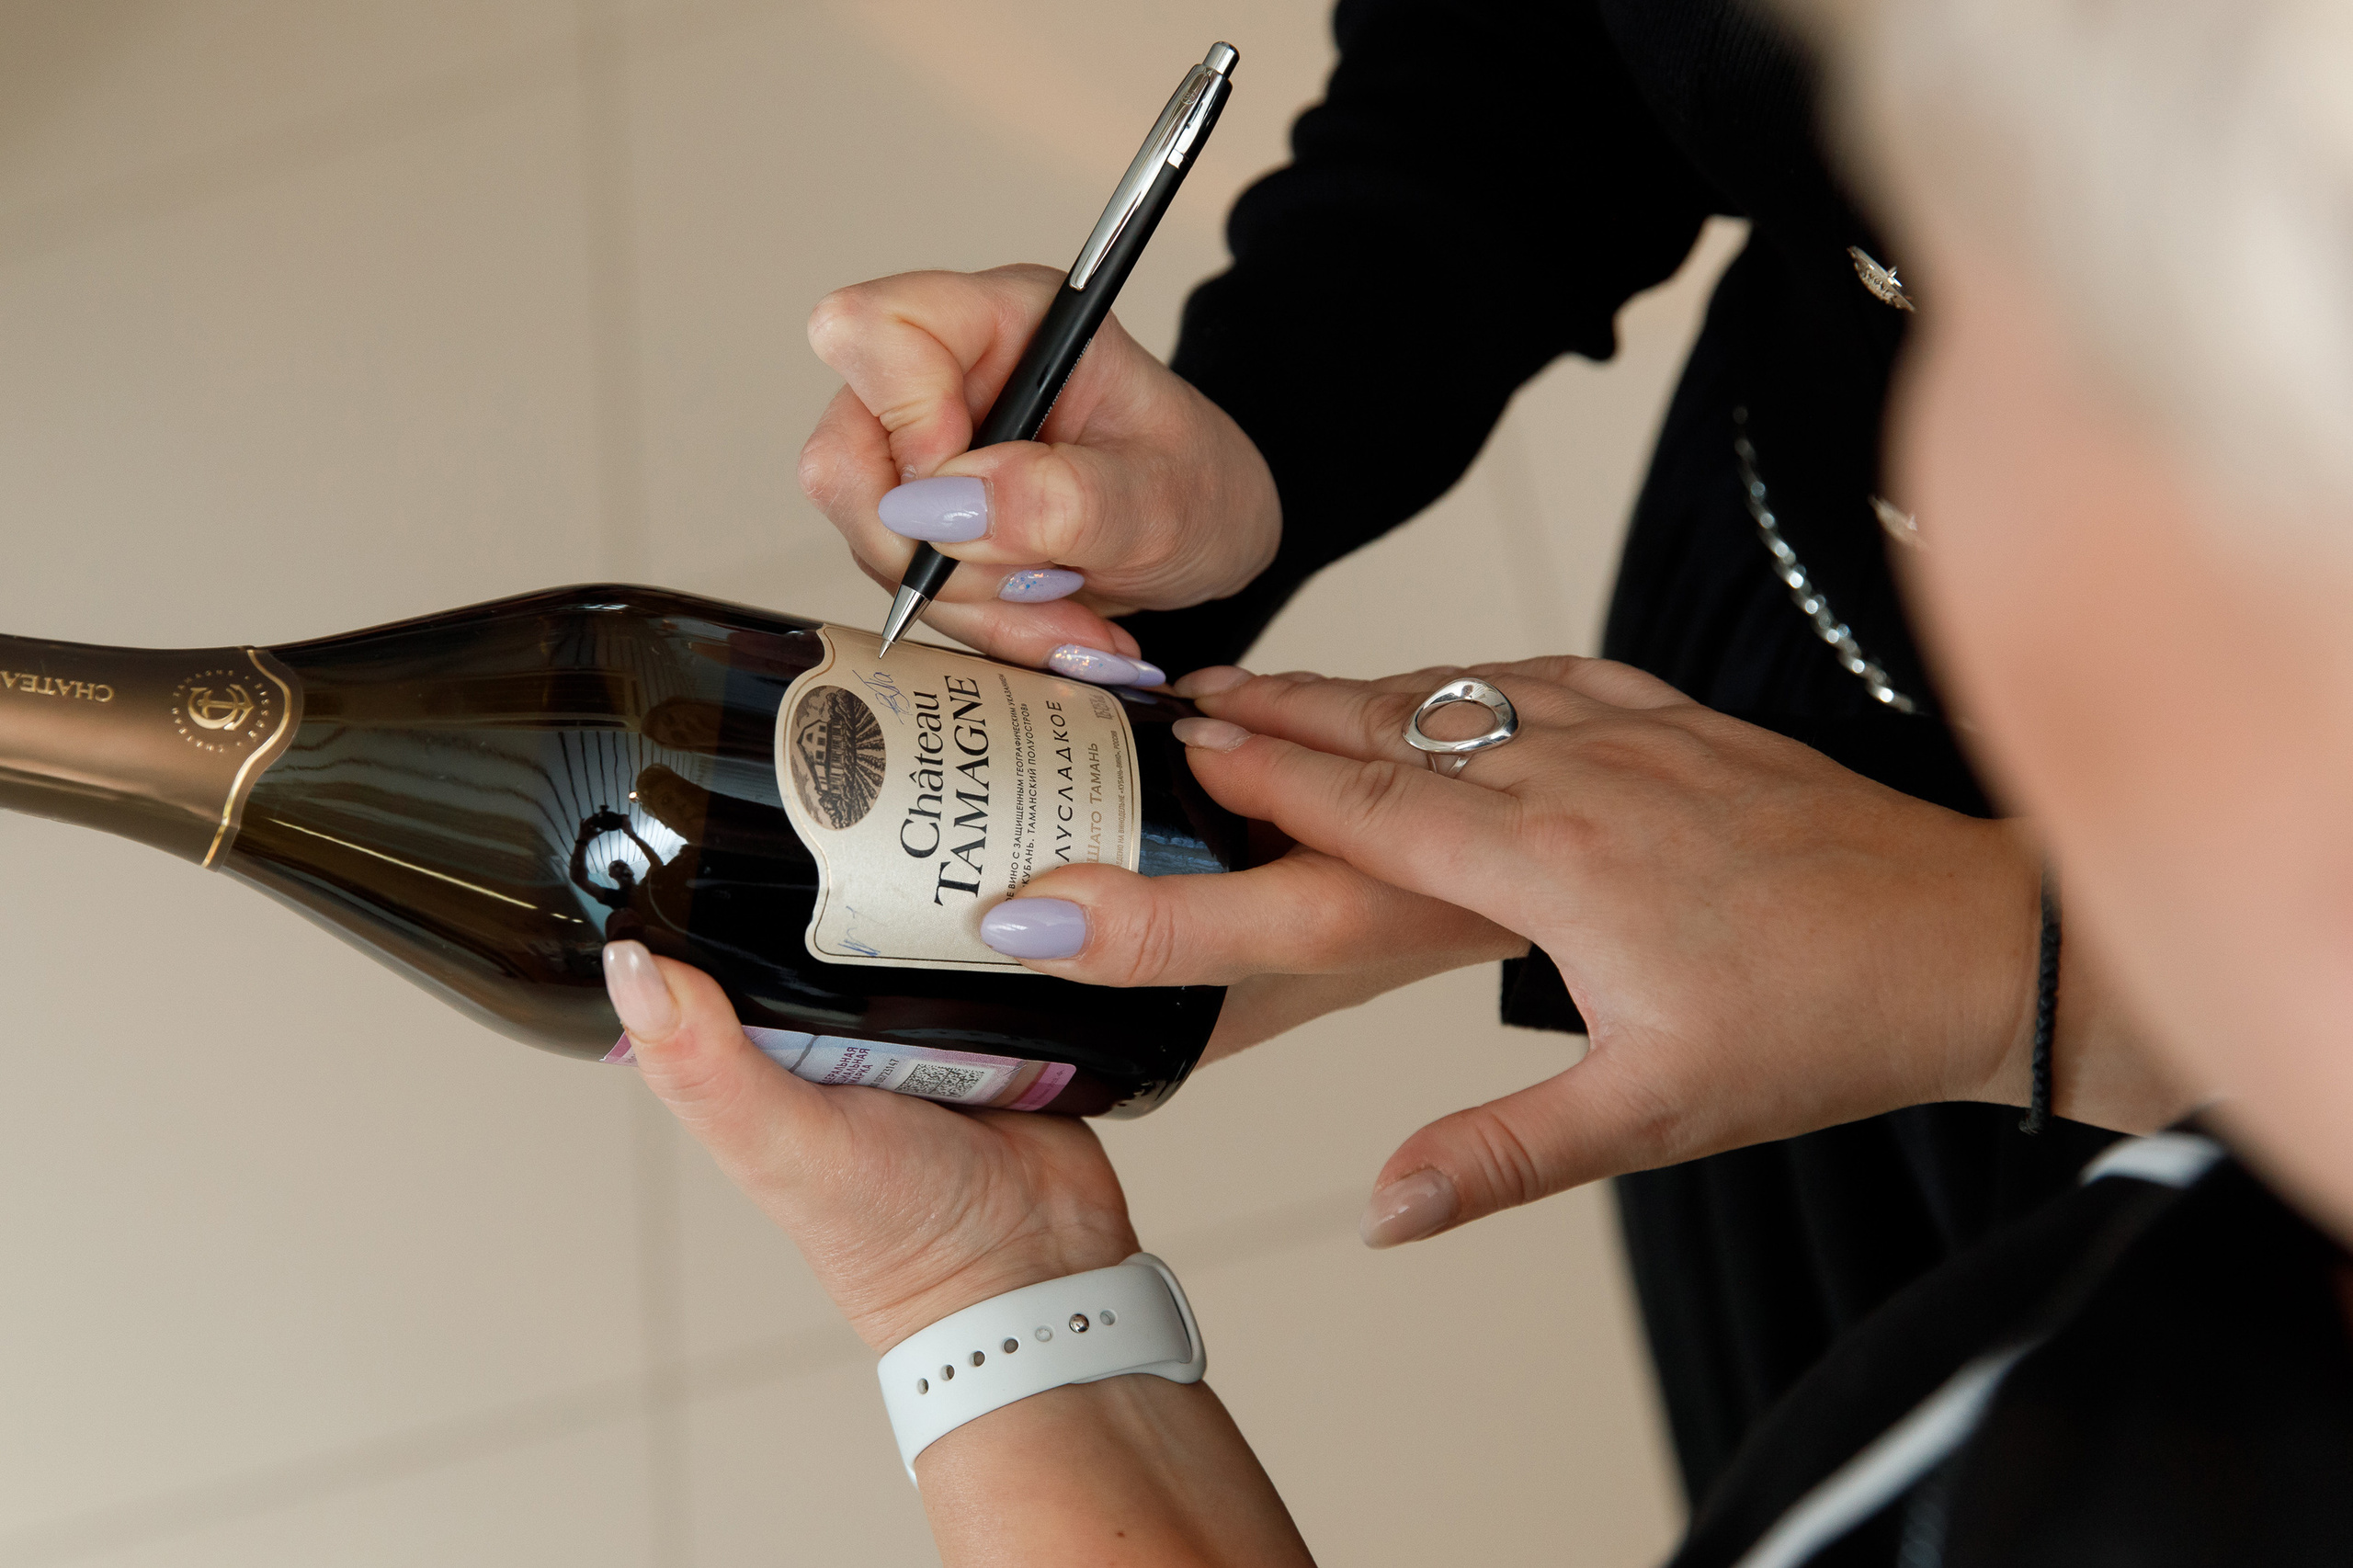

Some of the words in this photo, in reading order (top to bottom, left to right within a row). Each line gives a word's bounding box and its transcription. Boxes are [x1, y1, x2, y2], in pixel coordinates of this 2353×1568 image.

[0, 671, 115, 702] CHATEA
[1010, 707, 1024, 777] ГЕОГРАФИЧЕСКИМ
[1020, 703, 1037, 766] ПОЛУОСТРОВ»
[900, 690, 944, 858] Château
[934, 675, 990, 907] TAMAGNE
[1027, 768, 1037, 834] ТАМАНСКИЙ
[1046, 700, 1073, 868] ЛУСЛАДКОЕ
[1087, 743, 1103, 805] ТАМАНЬ
[1013, 779, 1024, 849] ЗАЩИЩЕННЫМ
[1086, 811, 1103, 864] ШАТО
[1117, 835, 1125, 844] НА
[1007, 861, 1019, 889] ВИНО
[1012, 851, 1020, 859] С
[1022, 838, 1035, 888] КУБАНЬ.
